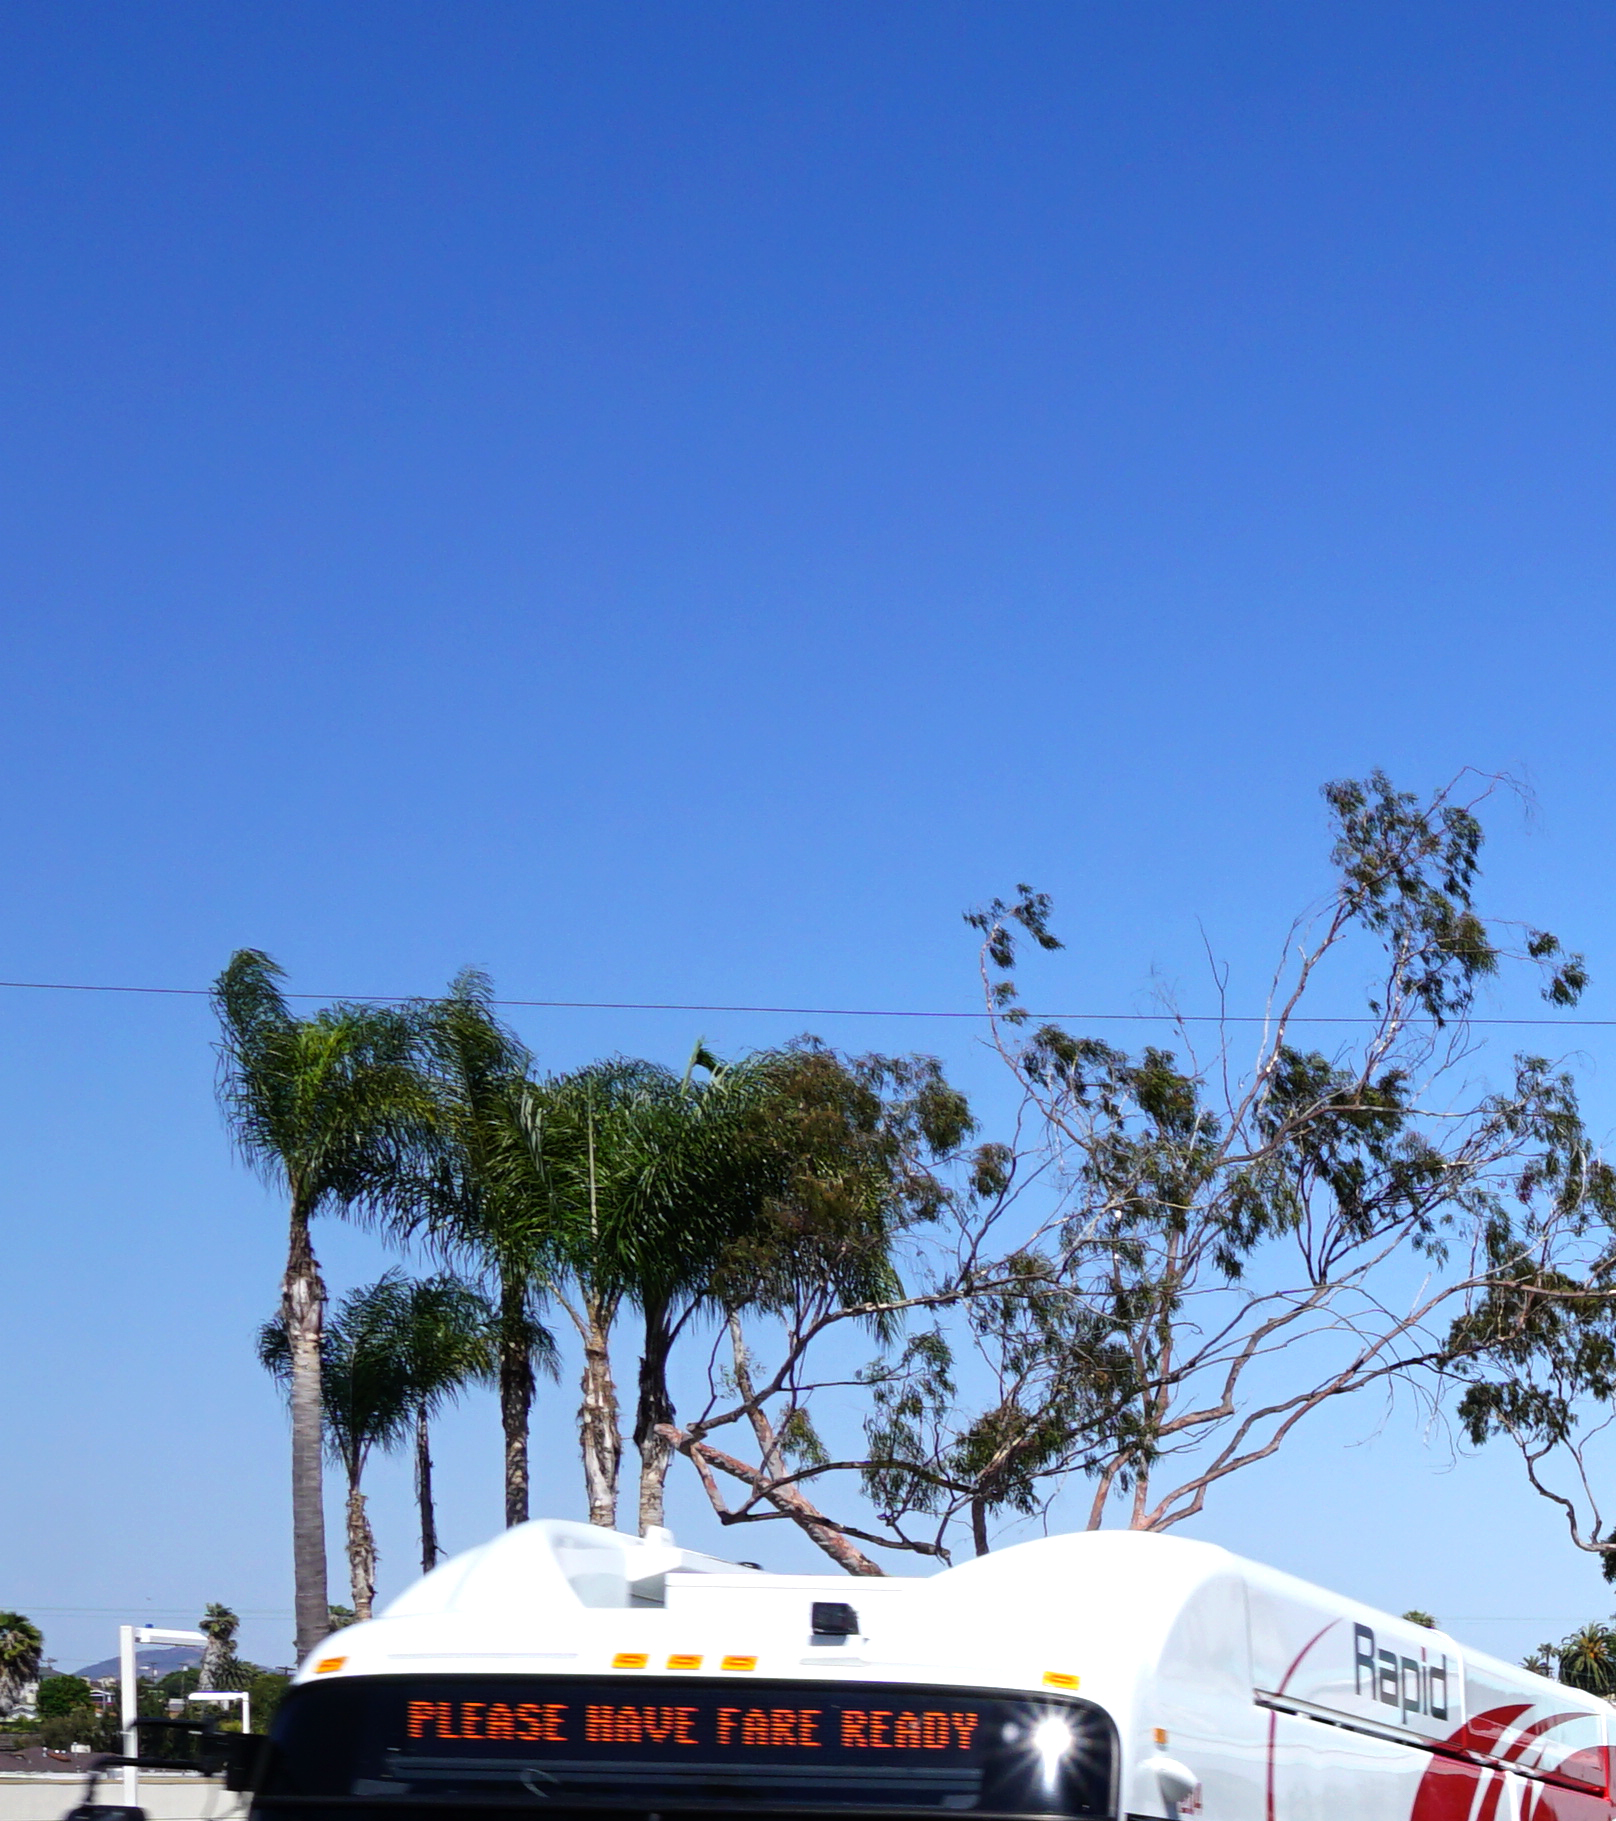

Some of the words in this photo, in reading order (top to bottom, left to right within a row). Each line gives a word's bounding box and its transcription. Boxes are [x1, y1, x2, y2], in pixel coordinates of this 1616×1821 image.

[1354, 1622, 1448, 1725] Rapid
[407, 1701, 569, 1741] PLEASE
[585, 1705, 700, 1745] HAVE
[716, 1707, 822, 1746] FARE
[840, 1710, 979, 1750] READY
